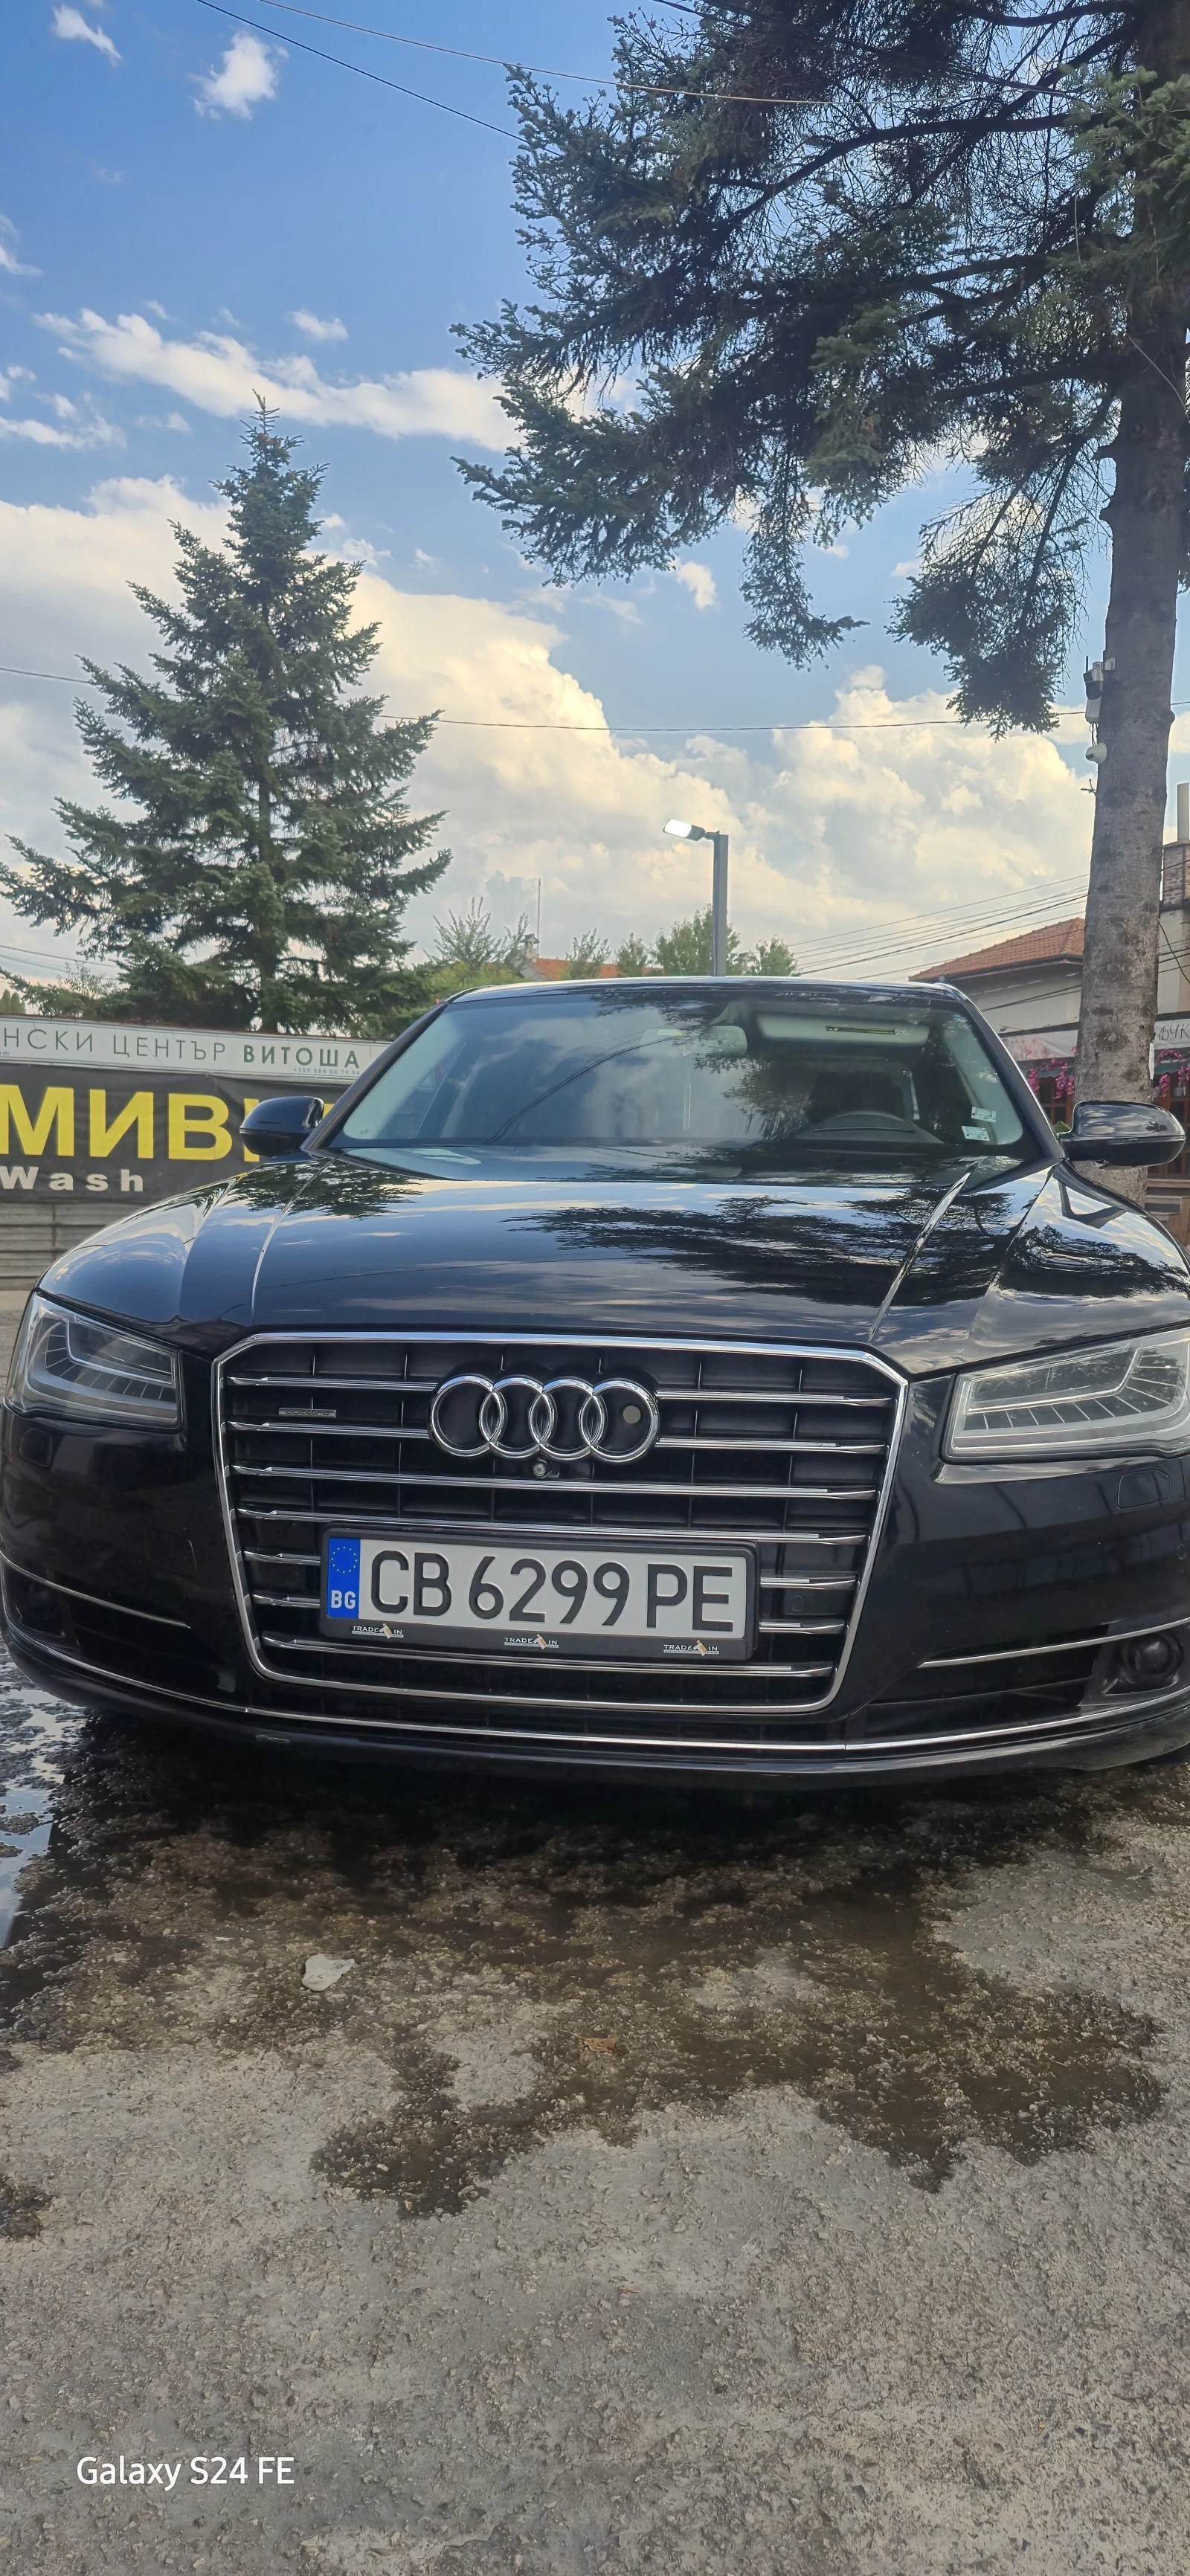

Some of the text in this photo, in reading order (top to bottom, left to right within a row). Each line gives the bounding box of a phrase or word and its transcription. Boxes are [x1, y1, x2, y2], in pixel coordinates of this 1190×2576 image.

[4, 1027, 360, 1069] НСКИ ЦЕНТЪР ВИТОША
[0, 1084, 335, 1162] МИВ
[0, 1165, 144, 1192] Wash
[331, 1589, 356, 1610] BG
[371, 1550, 734, 1632] CB 6299 PE
[352, 1625, 380, 1633] TRADE
